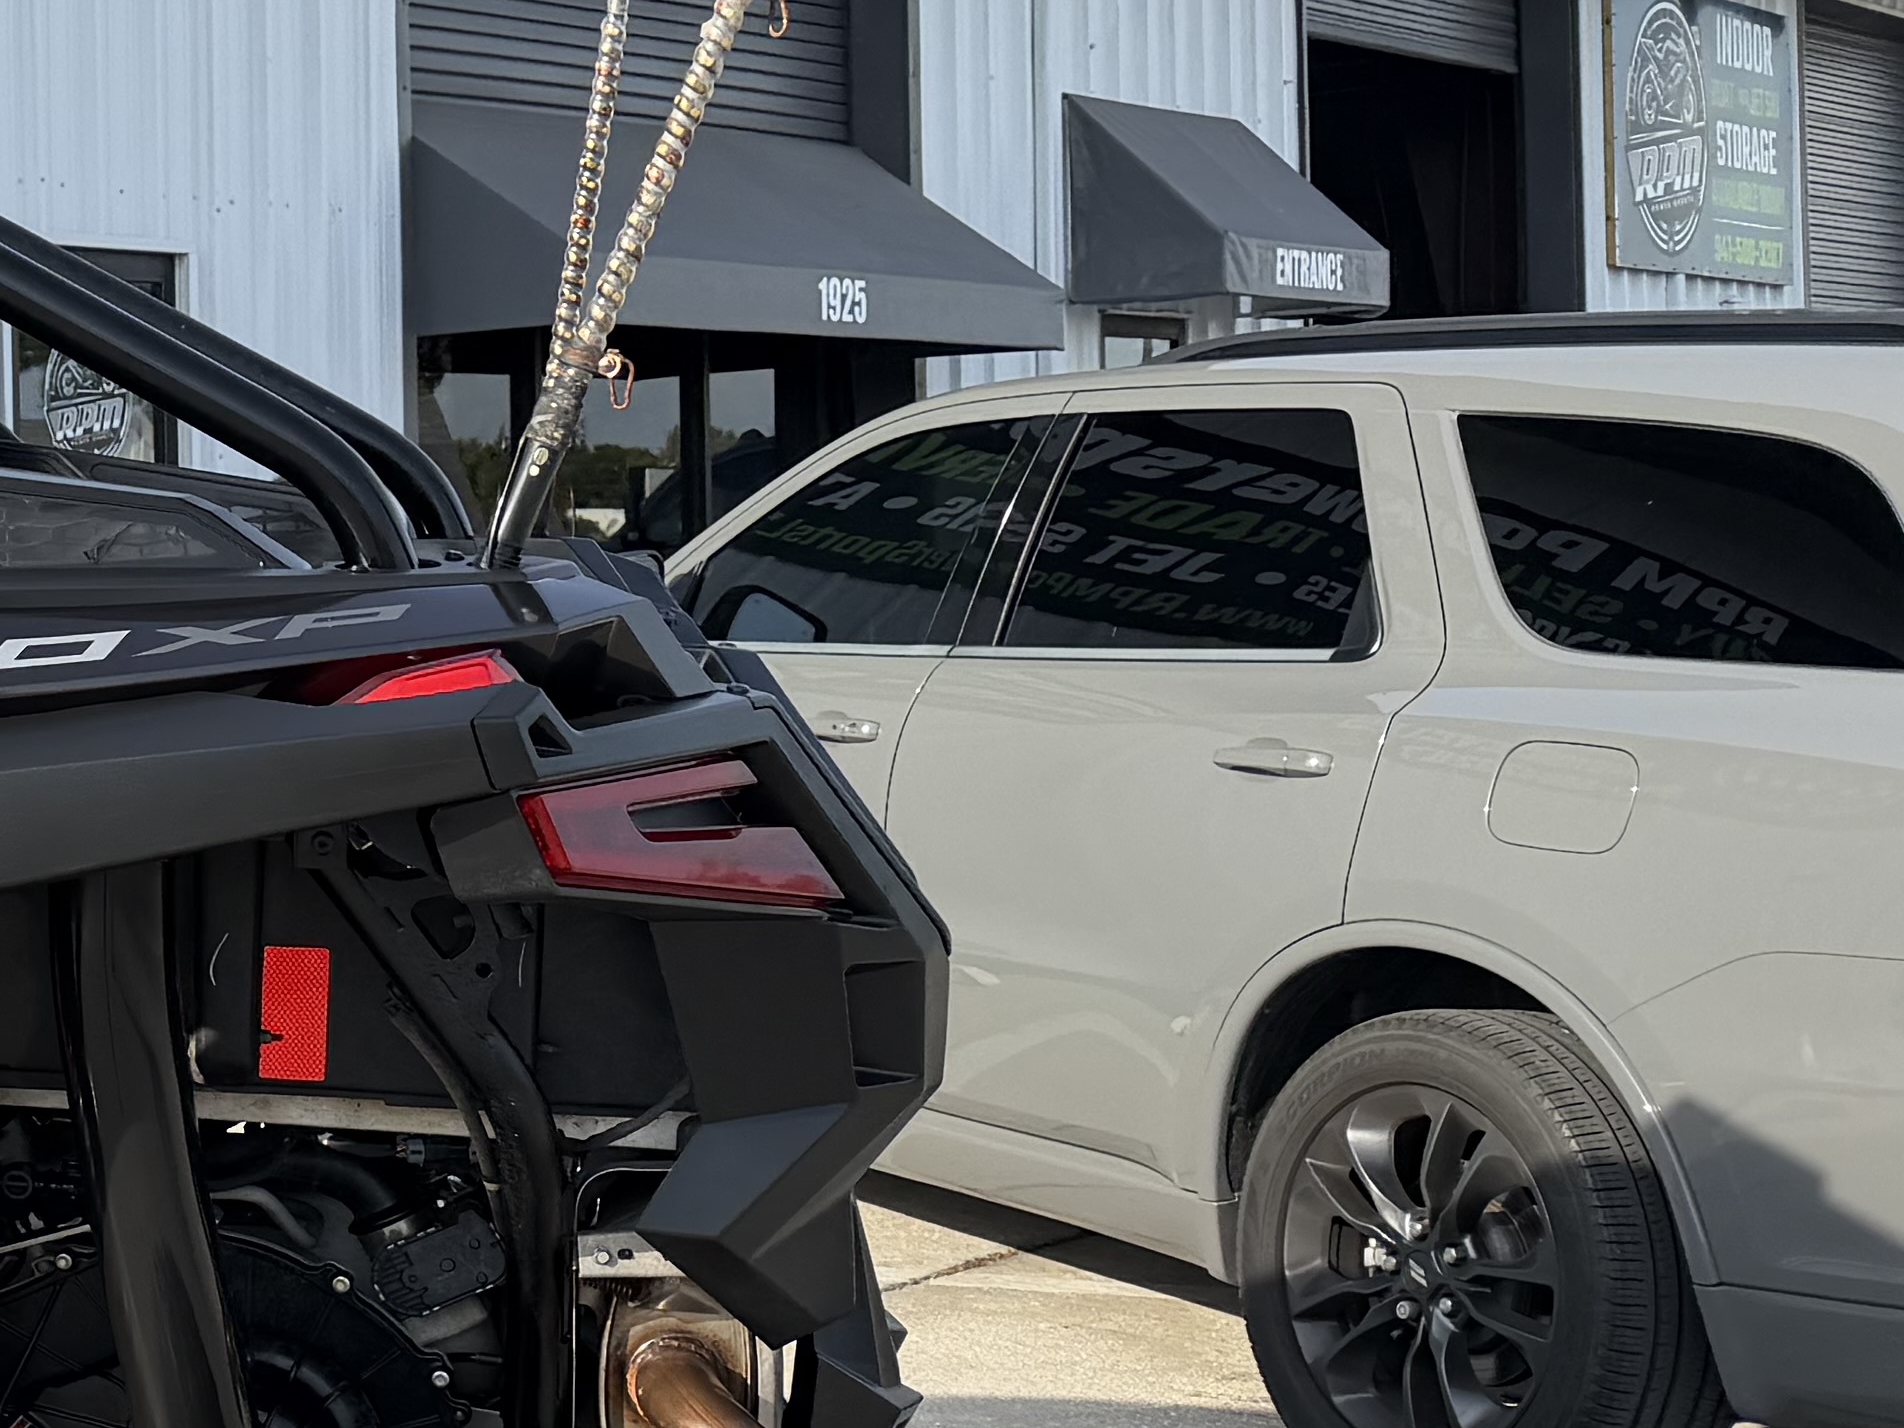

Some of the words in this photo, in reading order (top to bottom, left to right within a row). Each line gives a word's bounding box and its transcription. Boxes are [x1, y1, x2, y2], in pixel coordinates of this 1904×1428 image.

[1716, 12, 1773, 77] INDOOR
[1635, 135, 1702, 202] RPM
[1716, 120, 1777, 175] STORAGE
[1276, 247, 1344, 291] ENTRANCE
[818, 276, 867, 325] 1925
[56, 397, 124, 441] RPM
[132, 603, 412, 658] XP
